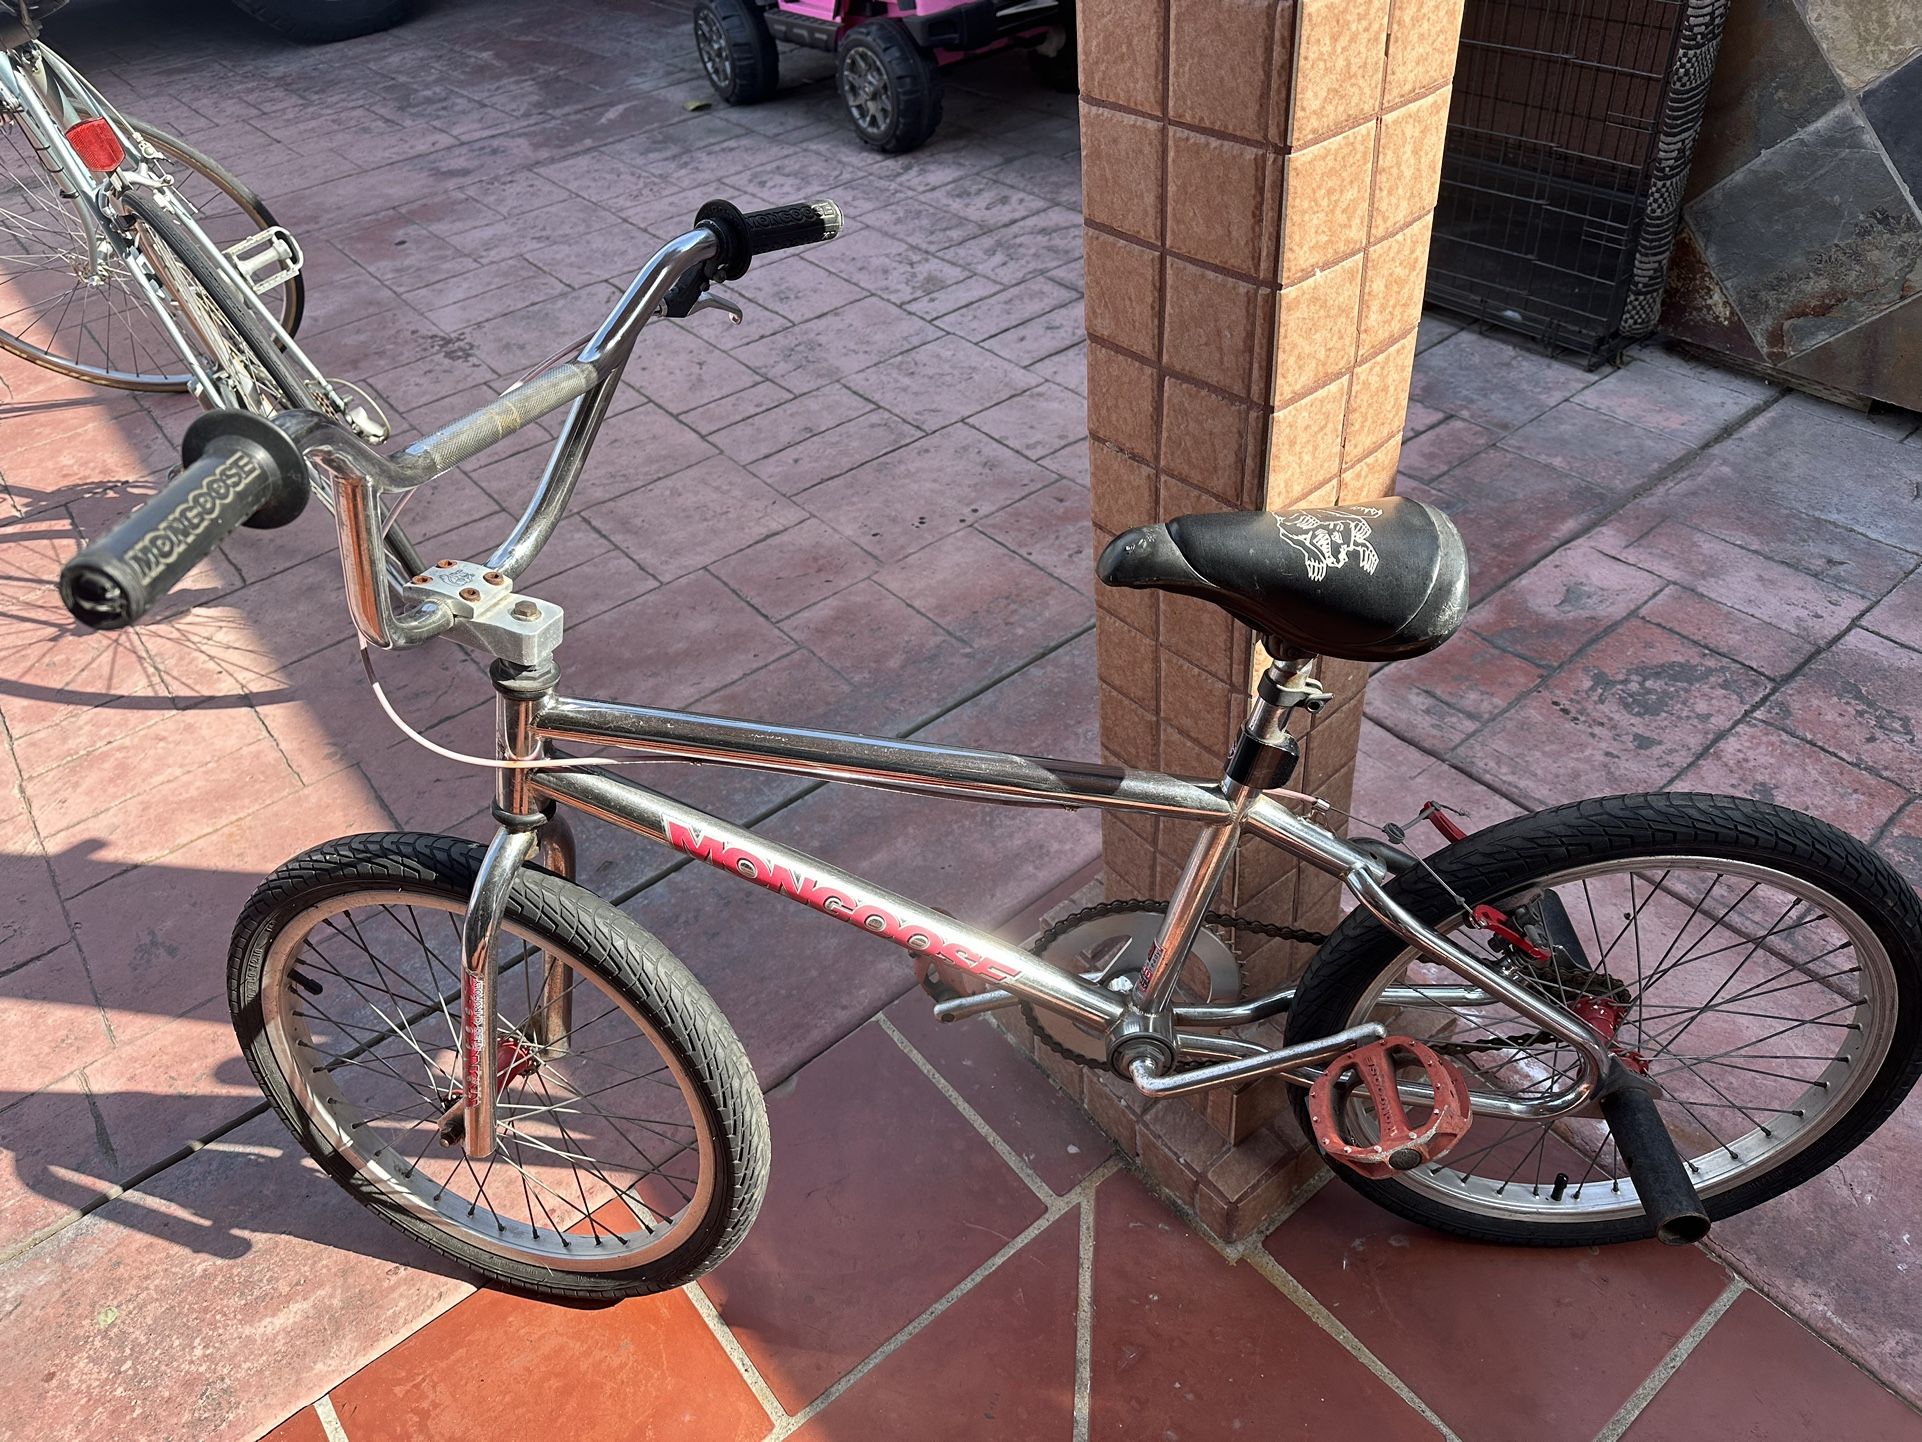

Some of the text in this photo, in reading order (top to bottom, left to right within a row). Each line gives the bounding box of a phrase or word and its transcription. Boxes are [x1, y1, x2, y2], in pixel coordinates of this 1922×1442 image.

[748, 202, 837, 231] MONGOOSE
[124, 451, 261, 585] MONGOOSE
[664, 815, 1022, 982] MONGOOSE
